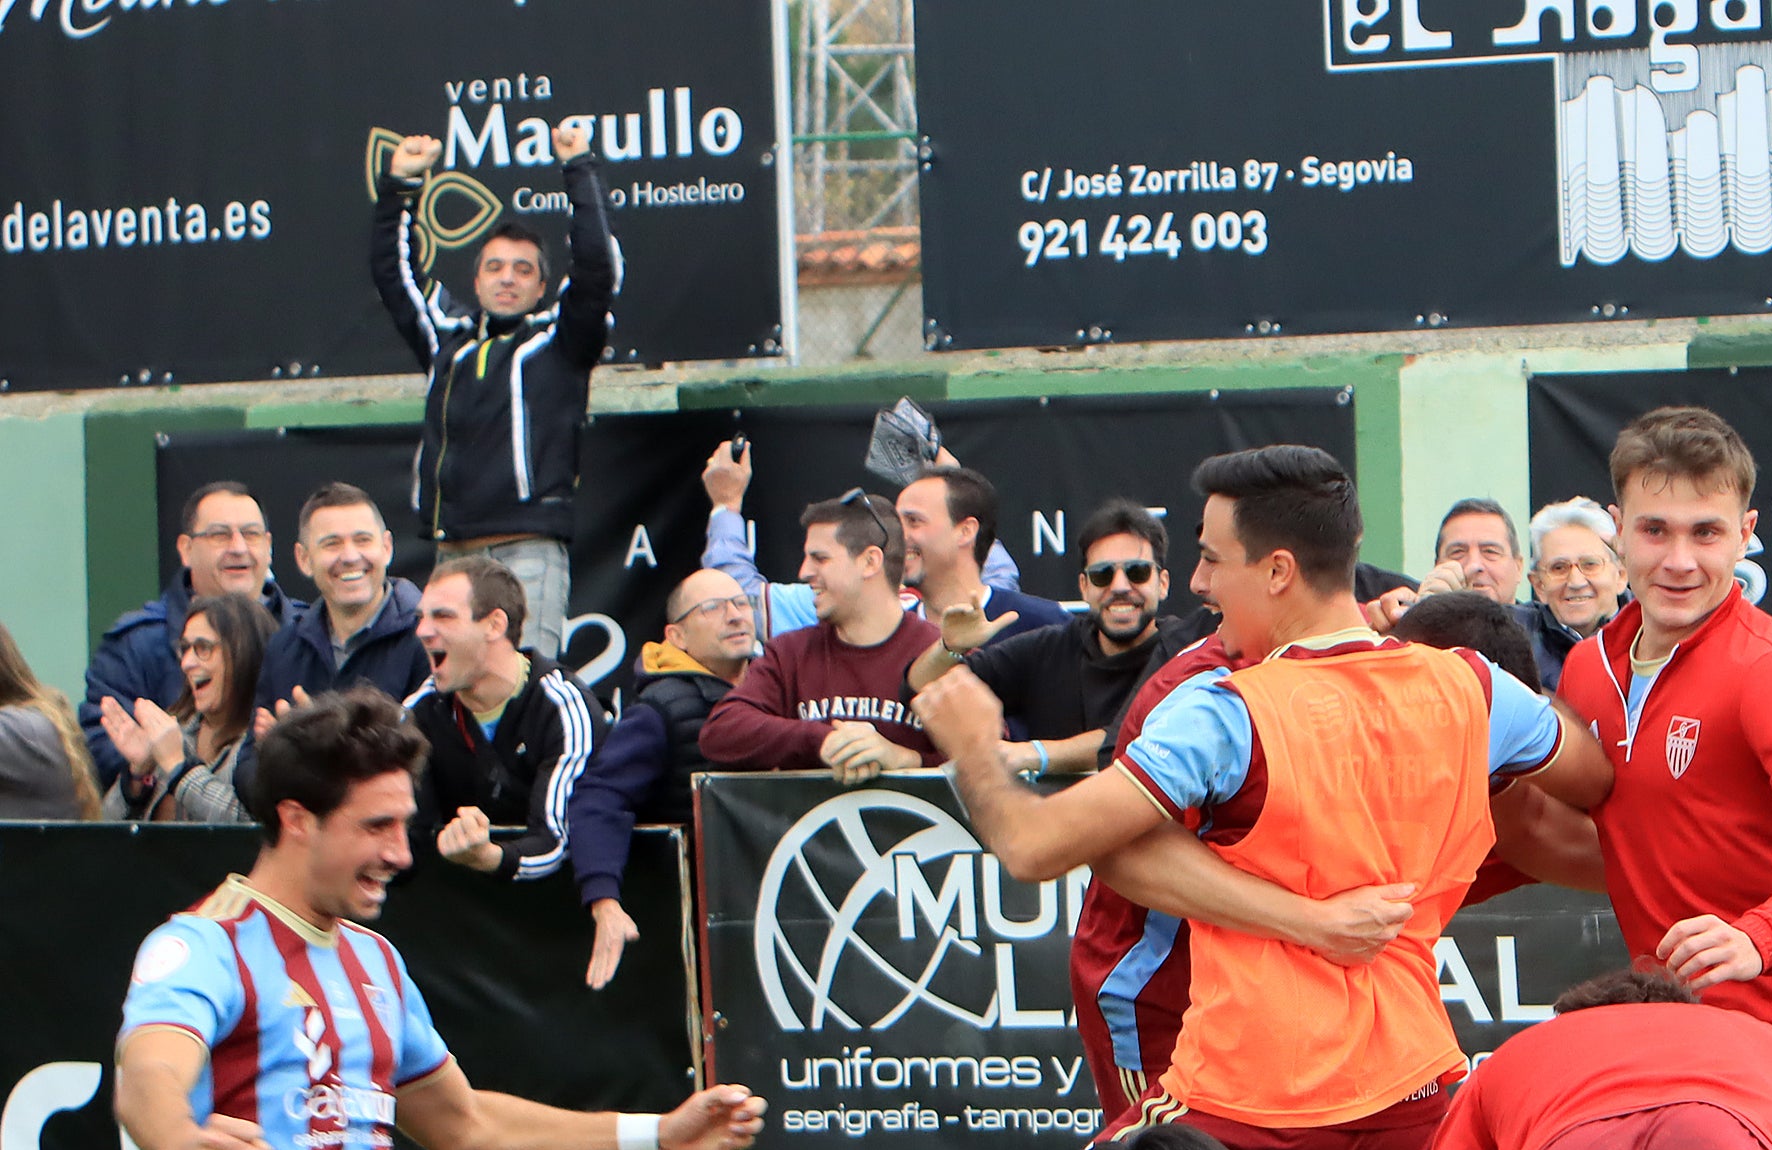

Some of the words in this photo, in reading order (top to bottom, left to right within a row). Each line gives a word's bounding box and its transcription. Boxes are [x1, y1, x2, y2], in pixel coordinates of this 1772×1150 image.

[445, 72, 552, 102] venta
[632, 176, 746, 209] Hostelero
[1057, 164, 1122, 199] José
[1128, 160, 1237, 195] Zorrilla
[1243, 158, 1280, 192] 87
[1300, 151, 1414, 192] Segovia
[2, 196, 272, 253] delaventa.es
[1018, 218, 1088, 268] 921
[1100, 210, 1182, 262] 424
[1190, 209, 1269, 255] 003
[780, 1046, 1043, 1089] uniformes
[1050, 1056, 1083, 1096] y
